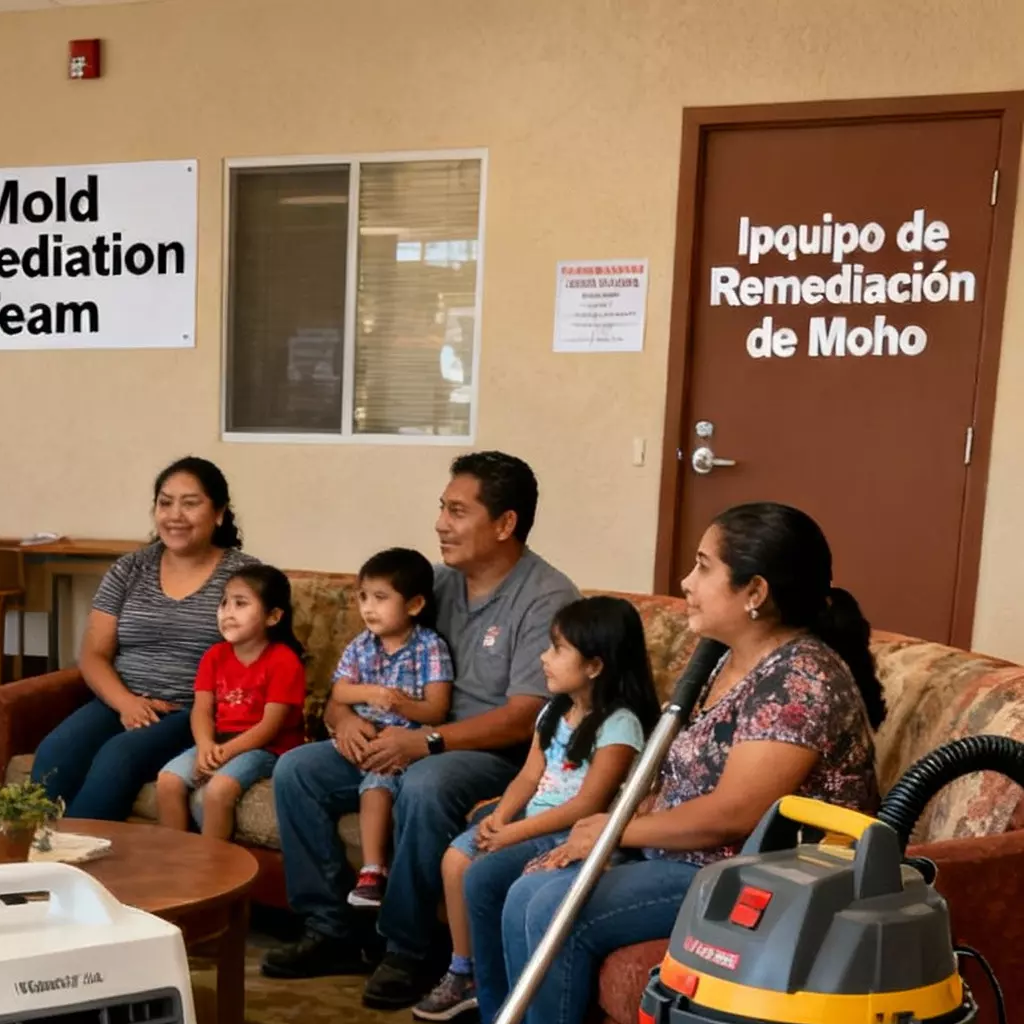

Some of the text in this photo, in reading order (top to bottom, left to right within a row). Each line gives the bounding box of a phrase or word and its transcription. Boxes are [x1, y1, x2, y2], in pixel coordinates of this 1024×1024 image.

[895, 208, 951, 253] de
[709, 259, 977, 307] Remediación
[745, 314, 928, 359] de Moho
